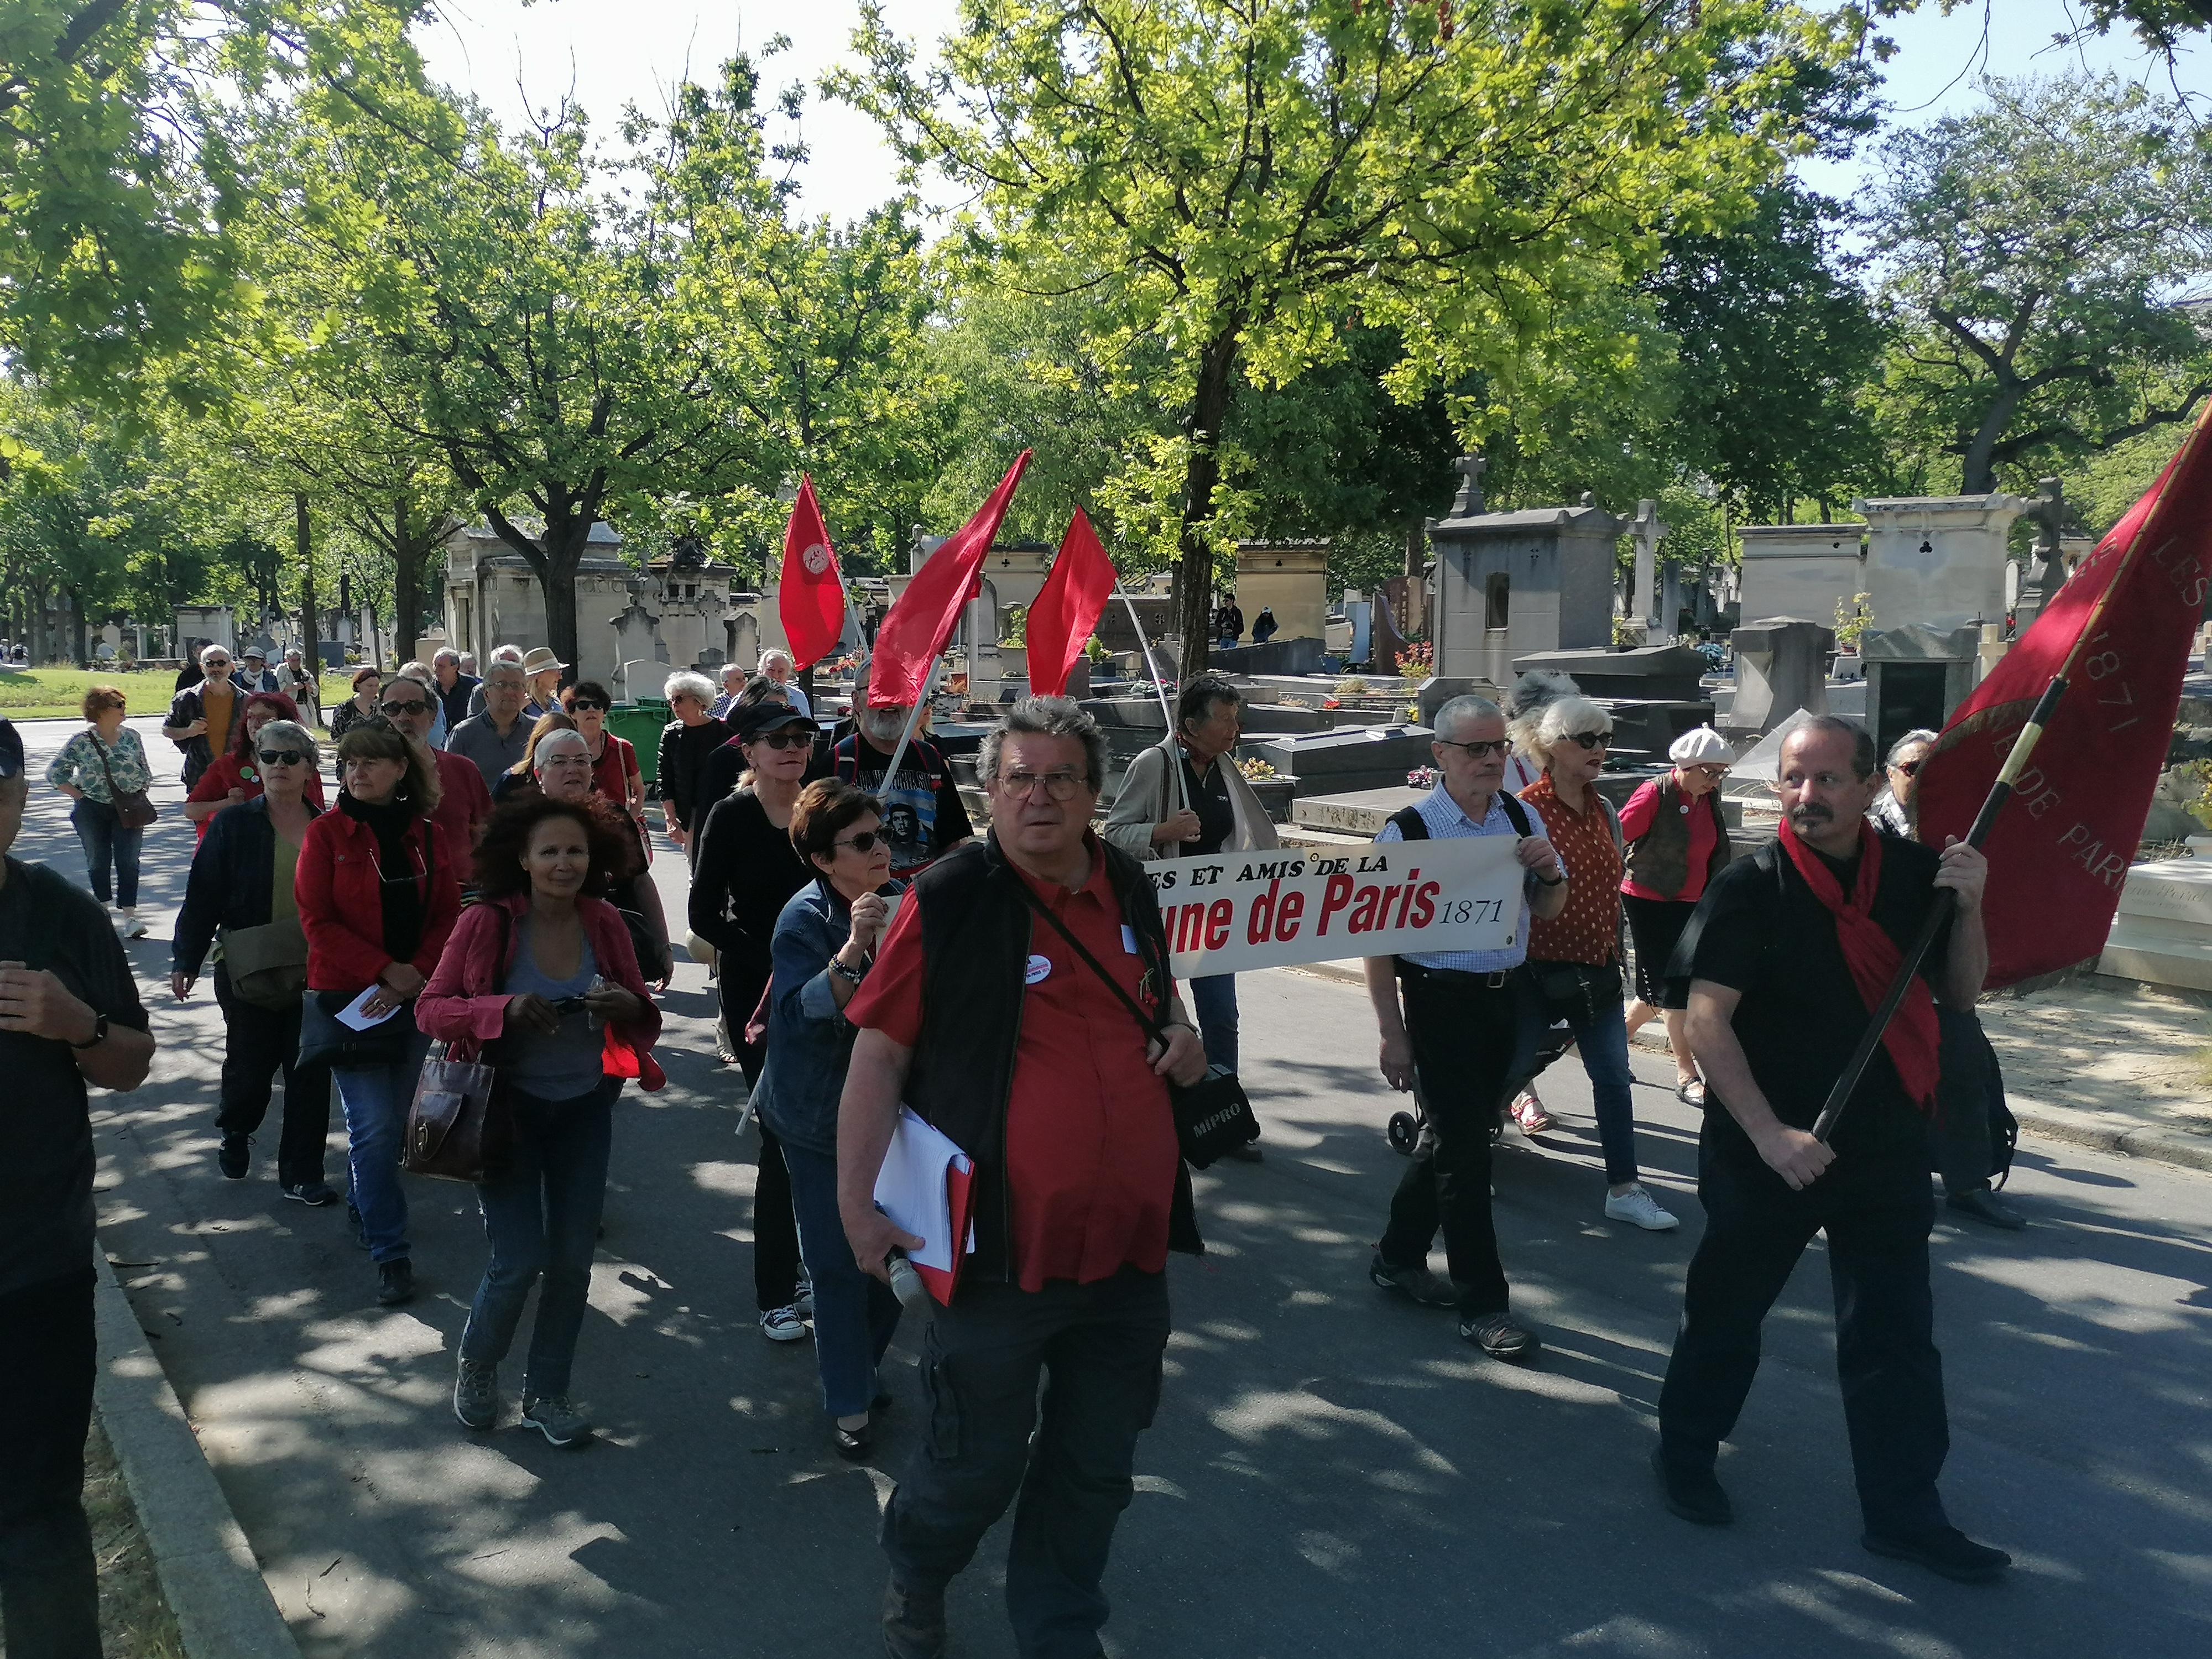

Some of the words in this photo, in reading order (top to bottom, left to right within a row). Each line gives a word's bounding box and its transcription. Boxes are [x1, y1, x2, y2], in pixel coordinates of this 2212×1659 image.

[2151, 535, 2209, 607] LES
[2085, 631, 2139, 732] 1871
[2011, 765, 2062, 820] DE
[1190, 865, 1224, 886] ET
[1236, 860, 1305, 881] AMIS
[1314, 857, 1349, 875] DE
[1357, 855, 1388, 873] LA
[1248, 878, 1305, 945] de
[1316, 868, 1440, 936] Paris
[1439, 899, 1503, 925] 1871
[1193, 1103, 1241, 1138] MIPRO
